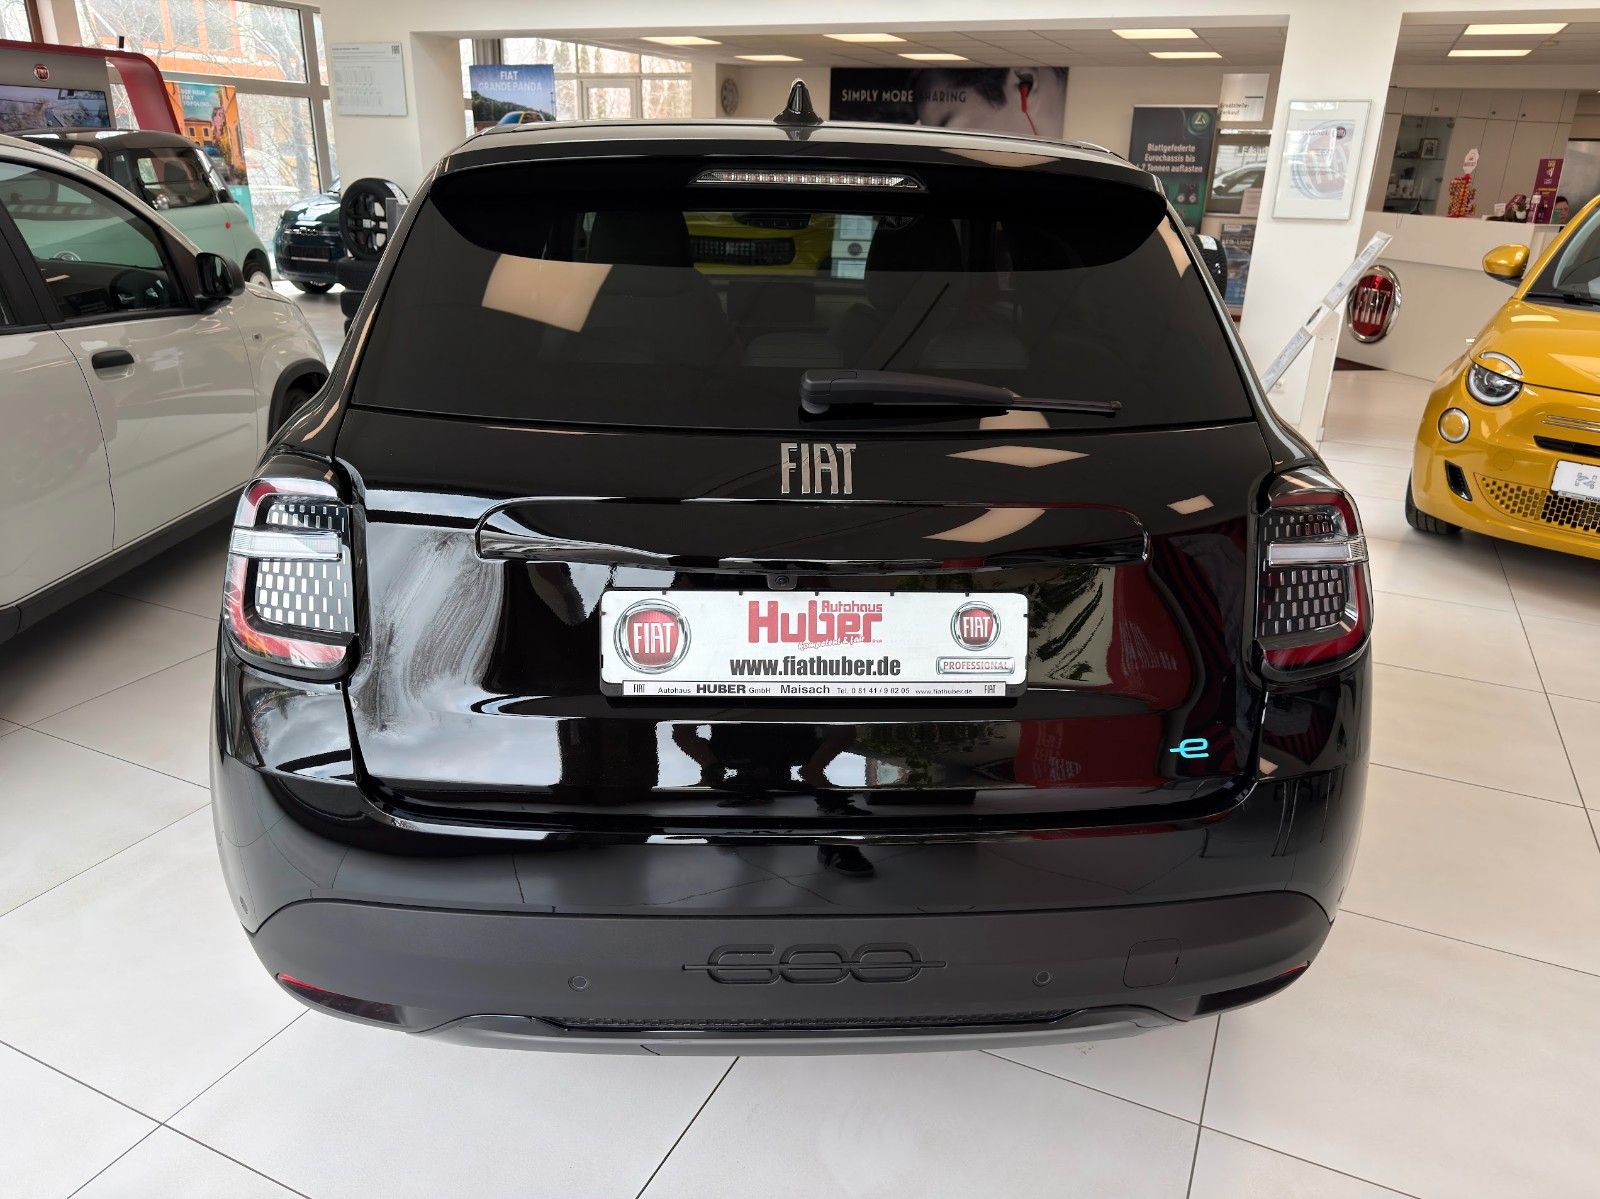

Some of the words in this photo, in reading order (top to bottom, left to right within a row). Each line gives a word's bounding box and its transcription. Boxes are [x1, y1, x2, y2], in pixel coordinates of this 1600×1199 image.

[500, 70, 519, 80] FIAT
[479, 82, 512, 91] GRANDE
[513, 82, 543, 91] PANDA
[841, 90, 879, 102] SIMPLY
[881, 90, 914, 102] MORE
[1147, 143, 1196, 153] Blattgefederte
[1144, 154, 1184, 162] Eurochassis
[1185, 154, 1196, 163] bis
[1147, 164, 1170, 172] Tonnen
[1171, 164, 1203, 173] auflasten
[780, 442, 857, 495] FIAT
[821, 600, 883, 612] Autohaus
[748, 600, 883, 644] Huber
[962, 616, 991, 638] FIAT
[633, 622, 675, 654] FIAT
[729, 656, 901, 676] www.fiathuber.de
[943, 661, 1009, 670] PROFESSIONAL
[633, 683, 645, 693] FIAT
[658, 686, 691, 694] Autohaus
[696, 684, 746, 694] HUBER
[749, 686, 771, 694] GmbH
[780, 684, 830, 694] Maisach
[984, 684, 996, 694] FIAT
[705, 943, 923, 985] 600
